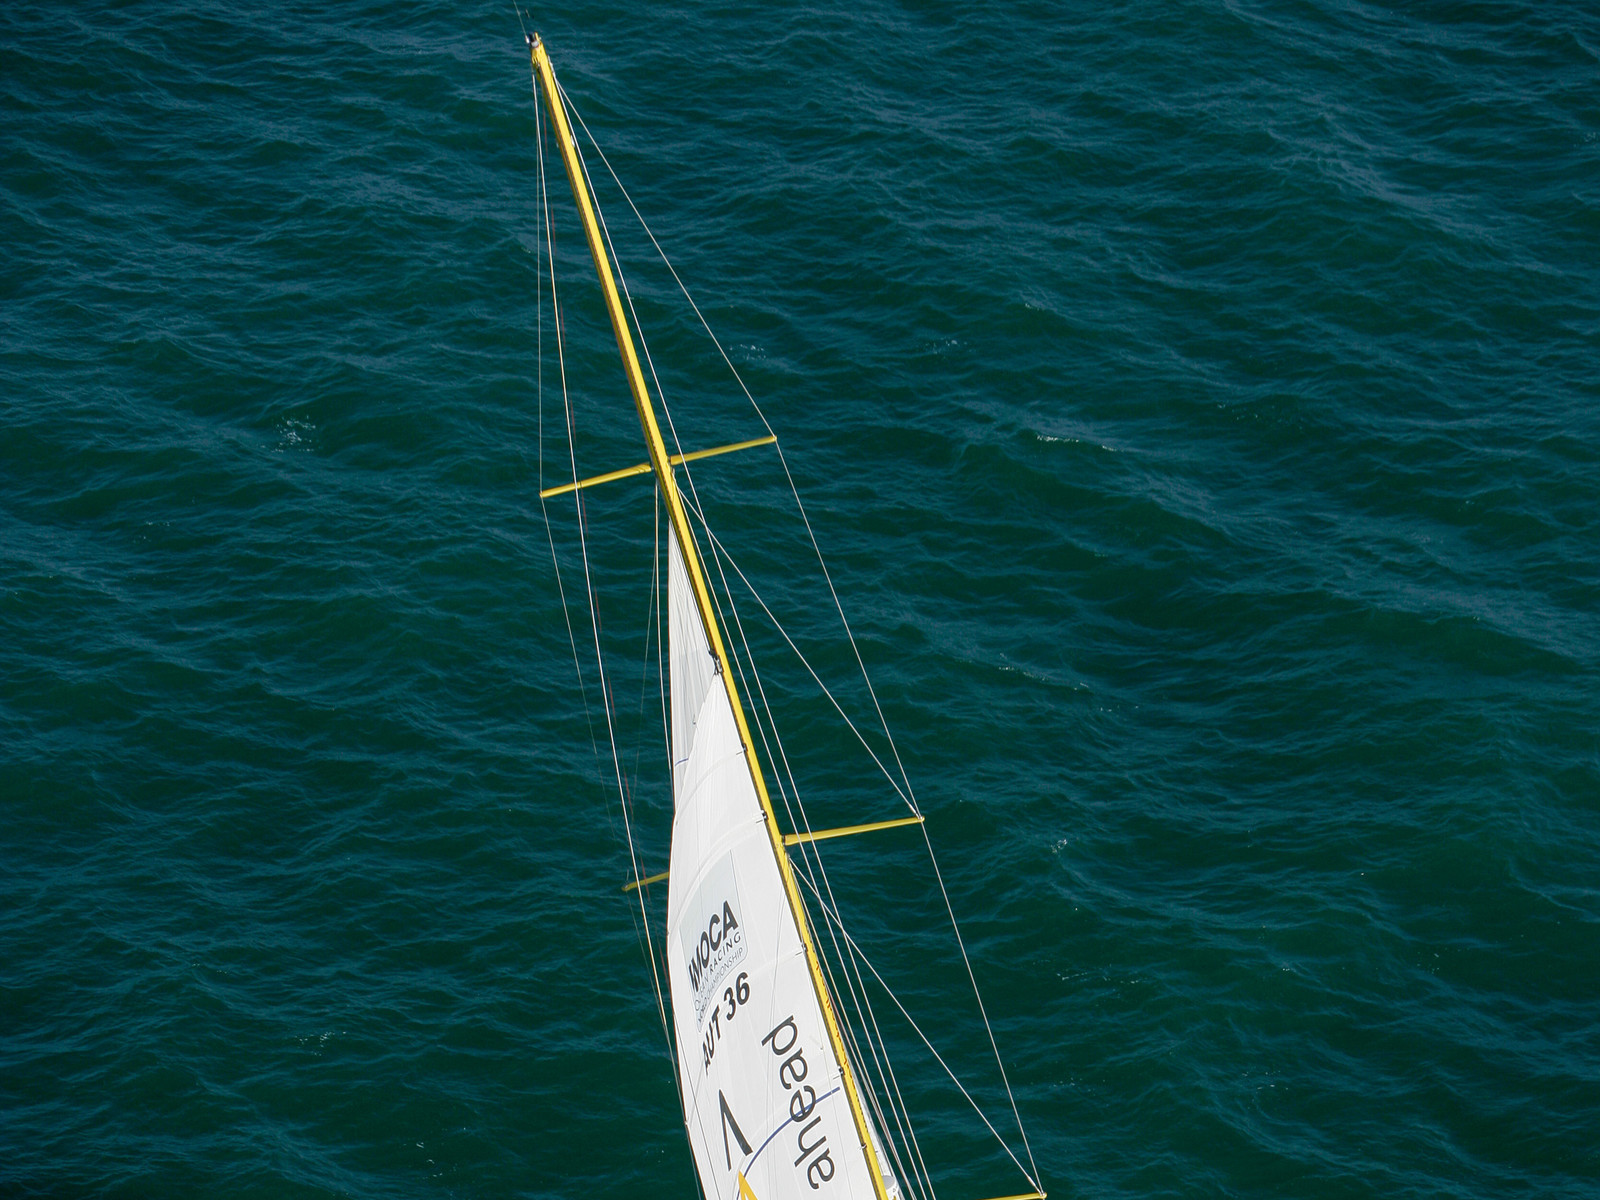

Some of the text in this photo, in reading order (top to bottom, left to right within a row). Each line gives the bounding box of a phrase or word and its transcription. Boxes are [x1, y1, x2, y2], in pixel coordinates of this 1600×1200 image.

[708, 931, 742, 972] RACING
[702, 971, 751, 1075] AUT 36
[761, 1015, 835, 1190] ahead
